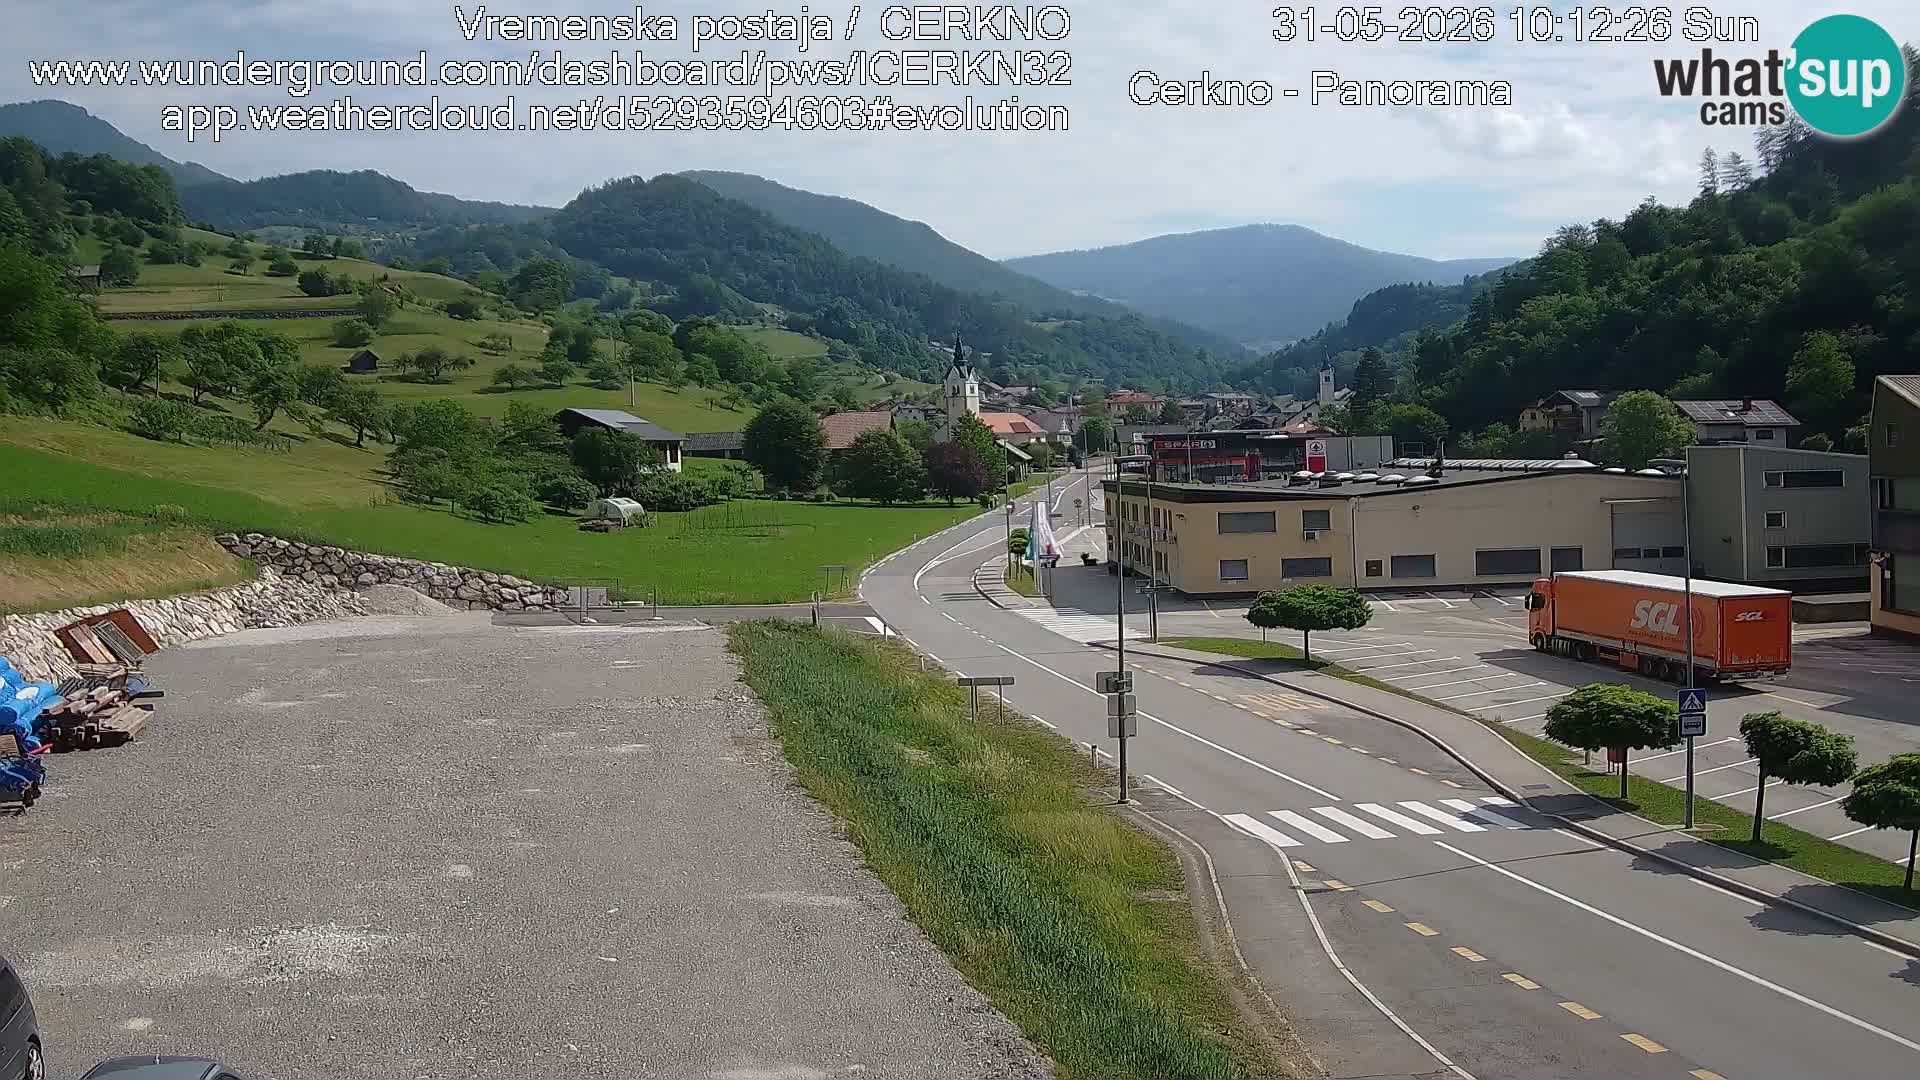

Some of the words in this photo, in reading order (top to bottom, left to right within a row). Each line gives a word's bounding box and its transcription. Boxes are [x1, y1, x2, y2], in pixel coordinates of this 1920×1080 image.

[1164, 441, 1201, 449] SPAR
[1631, 599, 1680, 635] SGL
[1735, 610, 1763, 622] SGL
